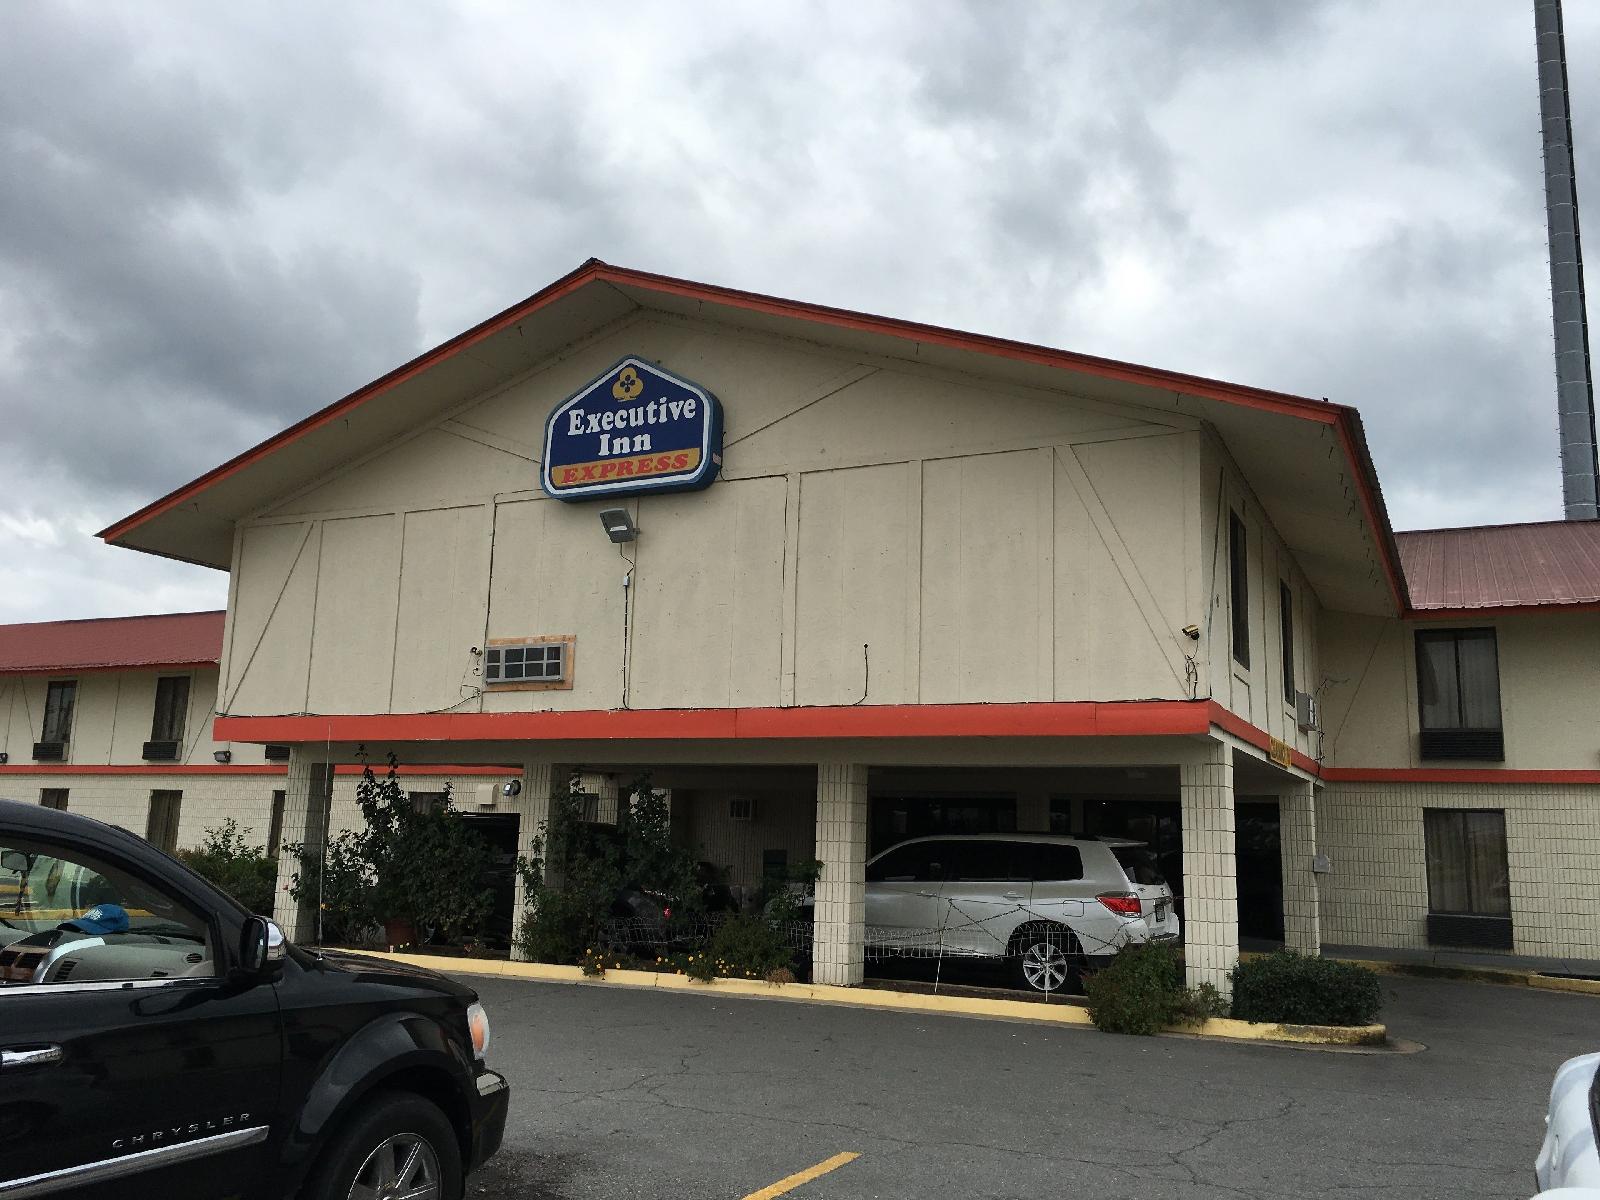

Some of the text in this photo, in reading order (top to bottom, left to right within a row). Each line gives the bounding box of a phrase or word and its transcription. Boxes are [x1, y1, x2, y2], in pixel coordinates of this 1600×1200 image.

[567, 396, 697, 436] Executive
[597, 433, 652, 456] Inn
[560, 453, 689, 484] EXPRESS
[112, 1112, 251, 1148] CHRYSLER
